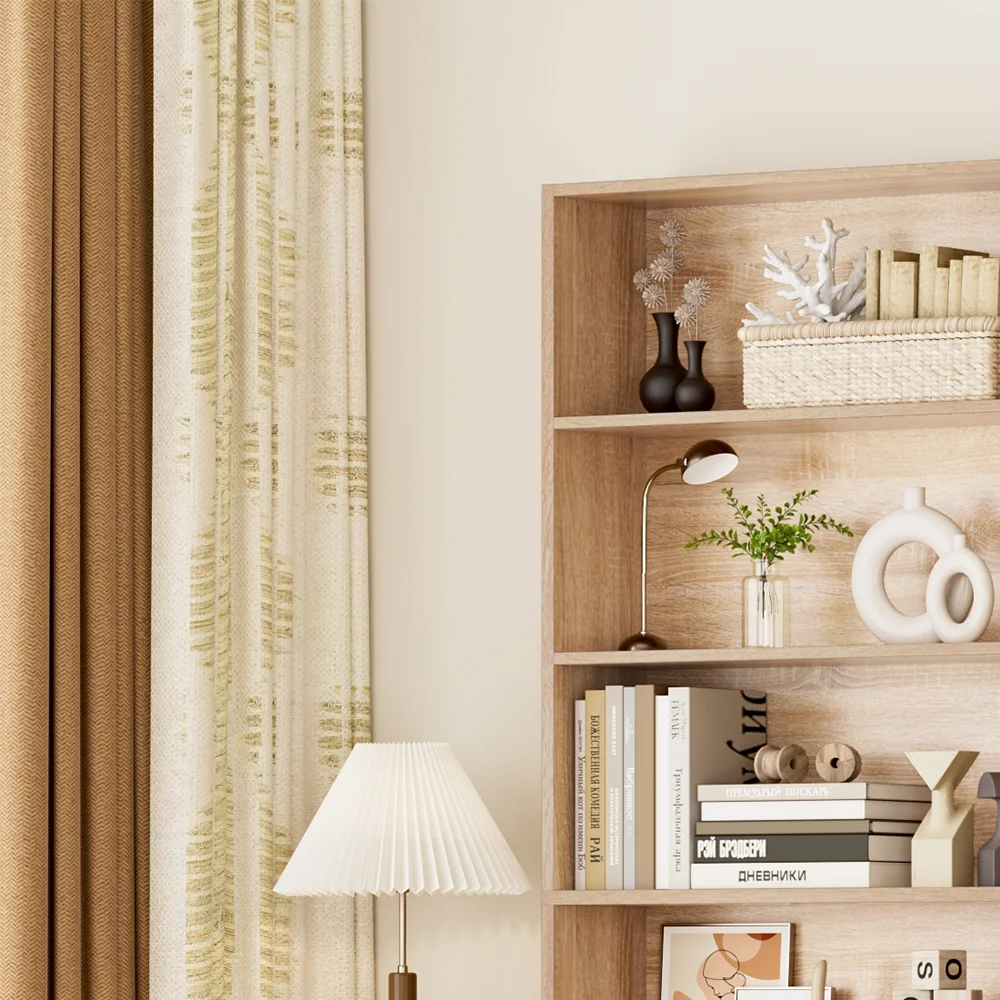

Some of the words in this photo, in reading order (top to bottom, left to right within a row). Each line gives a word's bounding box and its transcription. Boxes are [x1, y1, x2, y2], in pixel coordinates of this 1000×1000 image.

[590, 715, 601, 785] БОЖЕСТВЕННАЯ
[590, 787, 601, 829] КОМЕДИЯ
[590, 837, 603, 864] РАЙ
[698, 836, 716, 858] РЭЙ
[719, 839, 766, 858] БРЭДБЕРИ
[577, 854, 586, 871] Боб
[674, 849, 682, 872] арка
[738, 870, 807, 882] ДНЕВНИКИ
